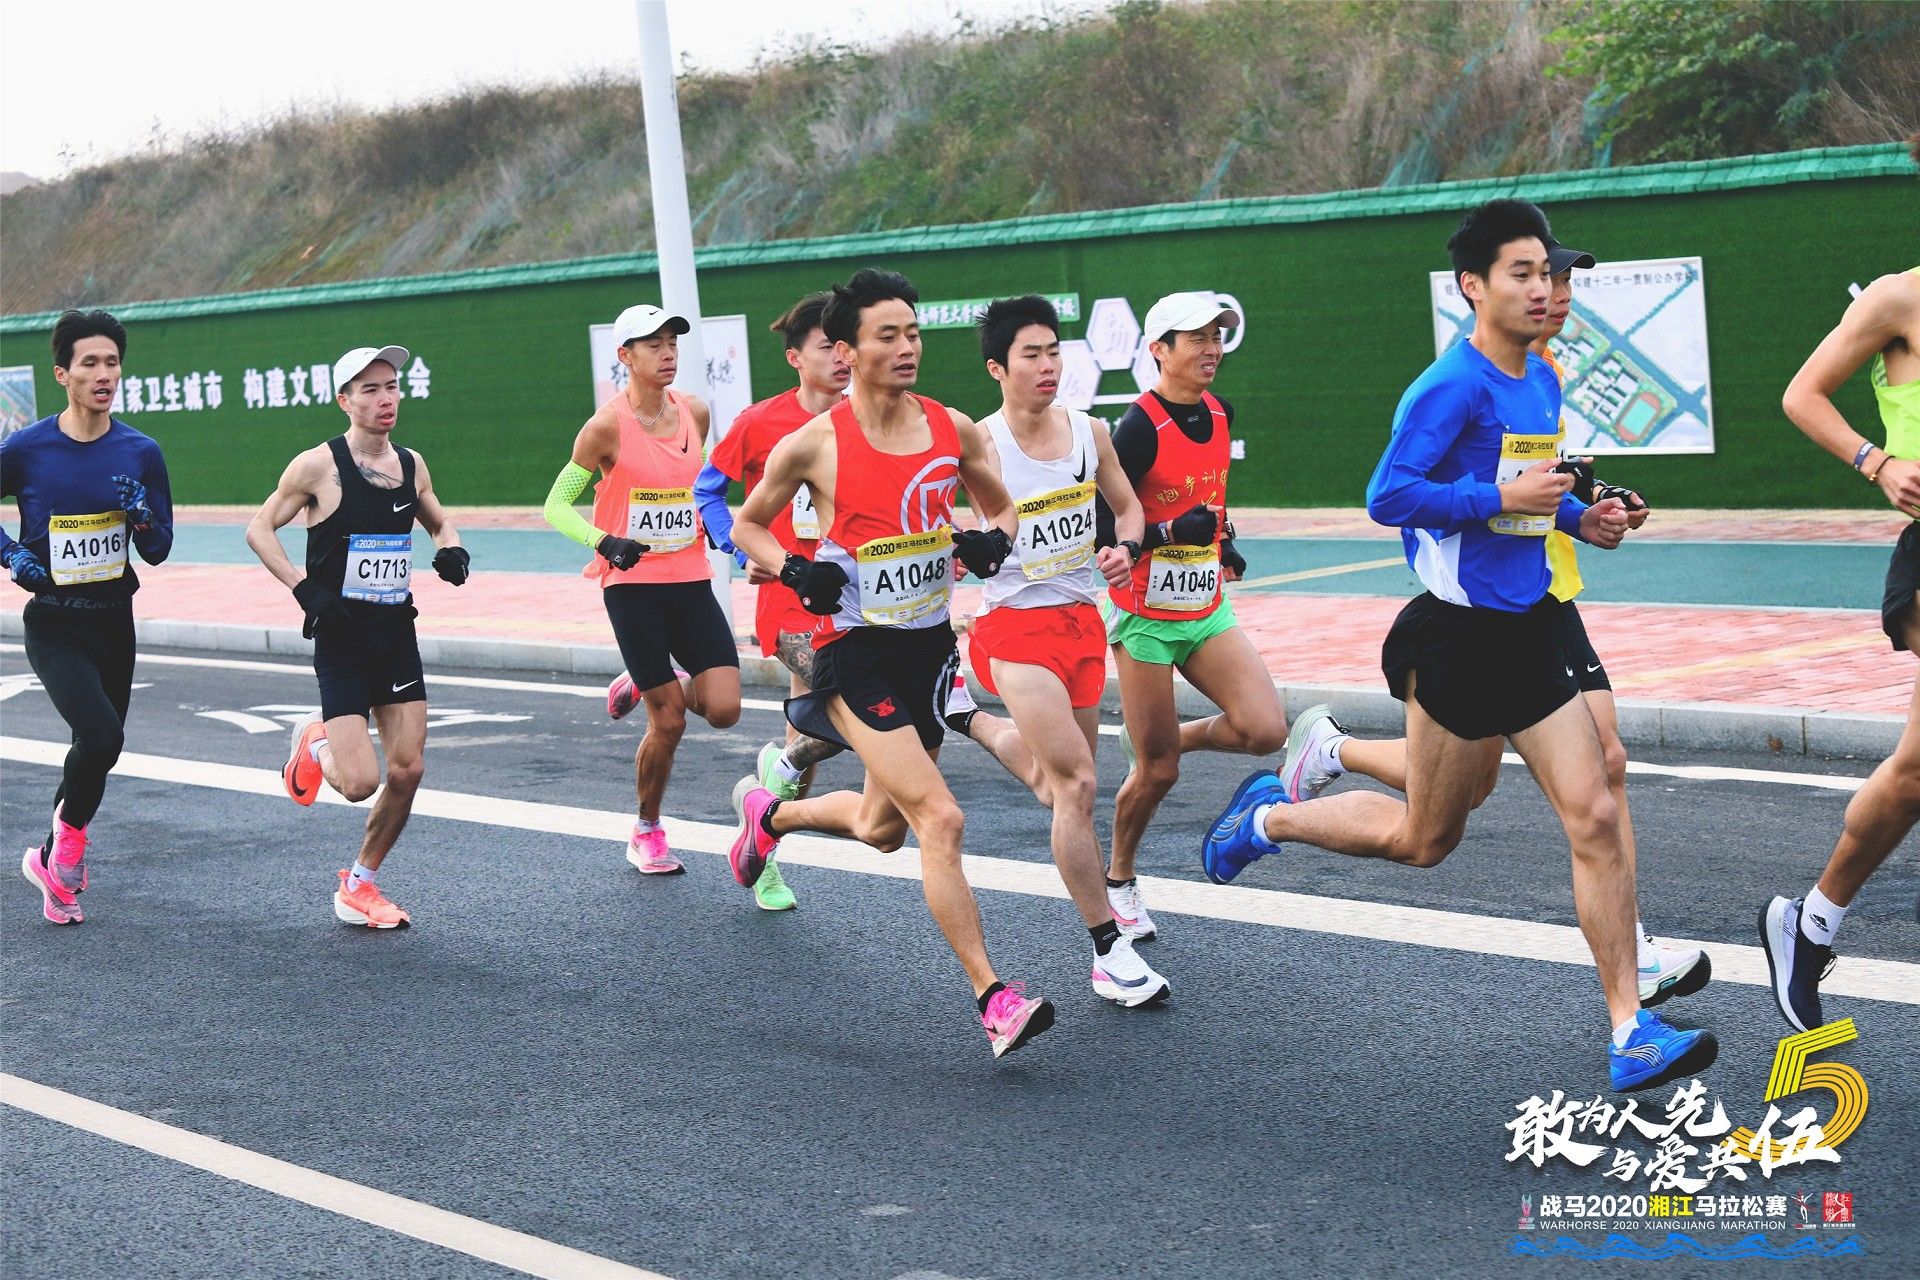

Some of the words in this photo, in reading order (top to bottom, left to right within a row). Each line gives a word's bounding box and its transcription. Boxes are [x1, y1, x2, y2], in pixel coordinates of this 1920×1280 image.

[638, 509, 693, 530] A1043
[1031, 508, 1093, 550] A1024
[62, 533, 121, 560] A1016
[358, 558, 407, 579] C1713
[875, 557, 946, 595] A1048
[1160, 569, 1215, 593] A1046
